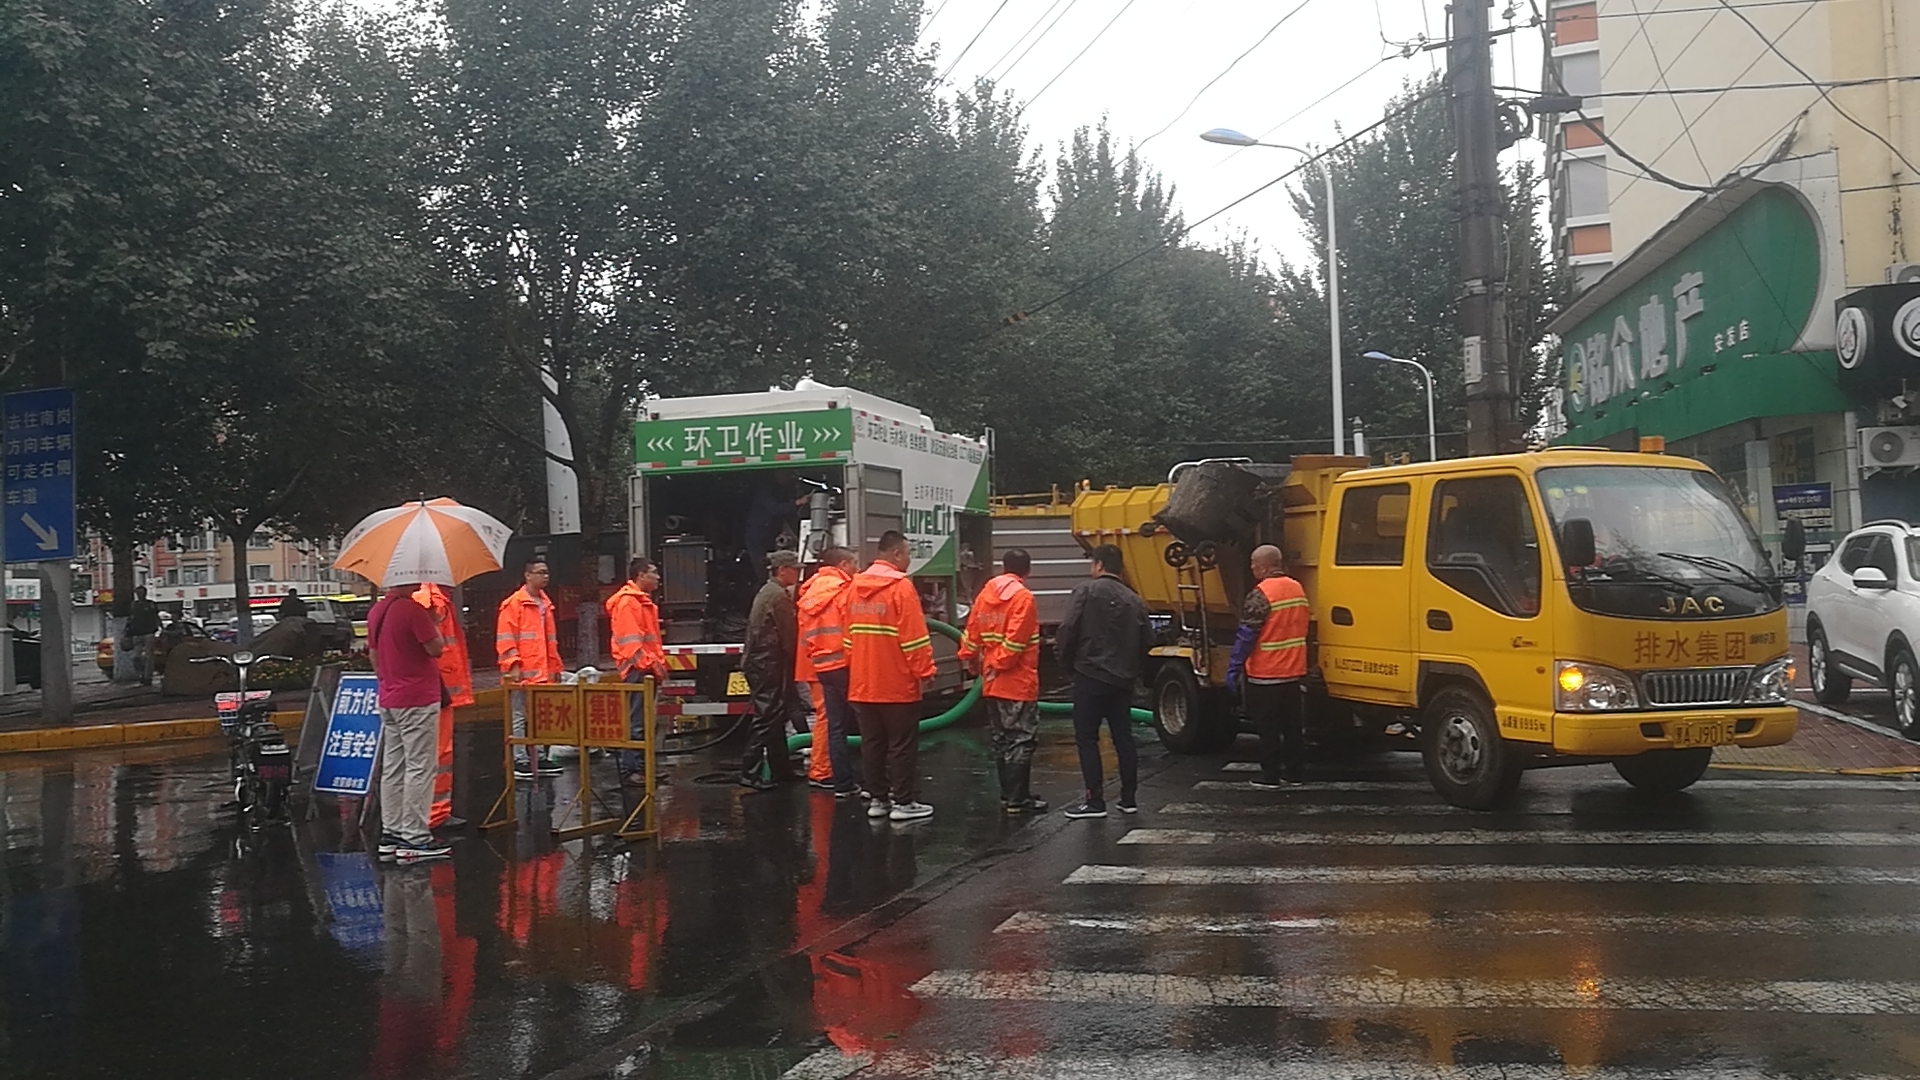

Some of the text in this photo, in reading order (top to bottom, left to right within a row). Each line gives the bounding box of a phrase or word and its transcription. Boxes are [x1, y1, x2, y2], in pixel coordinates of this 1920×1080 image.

[7, 408, 71, 430] 去往南岗
[7, 434, 72, 455] 方向车辆
[683, 420, 806, 458] 环卫作业
[7, 459, 72, 480] 可走右侧
[6, 487, 38, 506] 车道
[1659, 596, 1725, 615] JAC
[1634, 630, 1746, 664] 排水集团
[537, 693, 623, 732] 排水 集团
[326, 729, 377, 757] 注意安全
